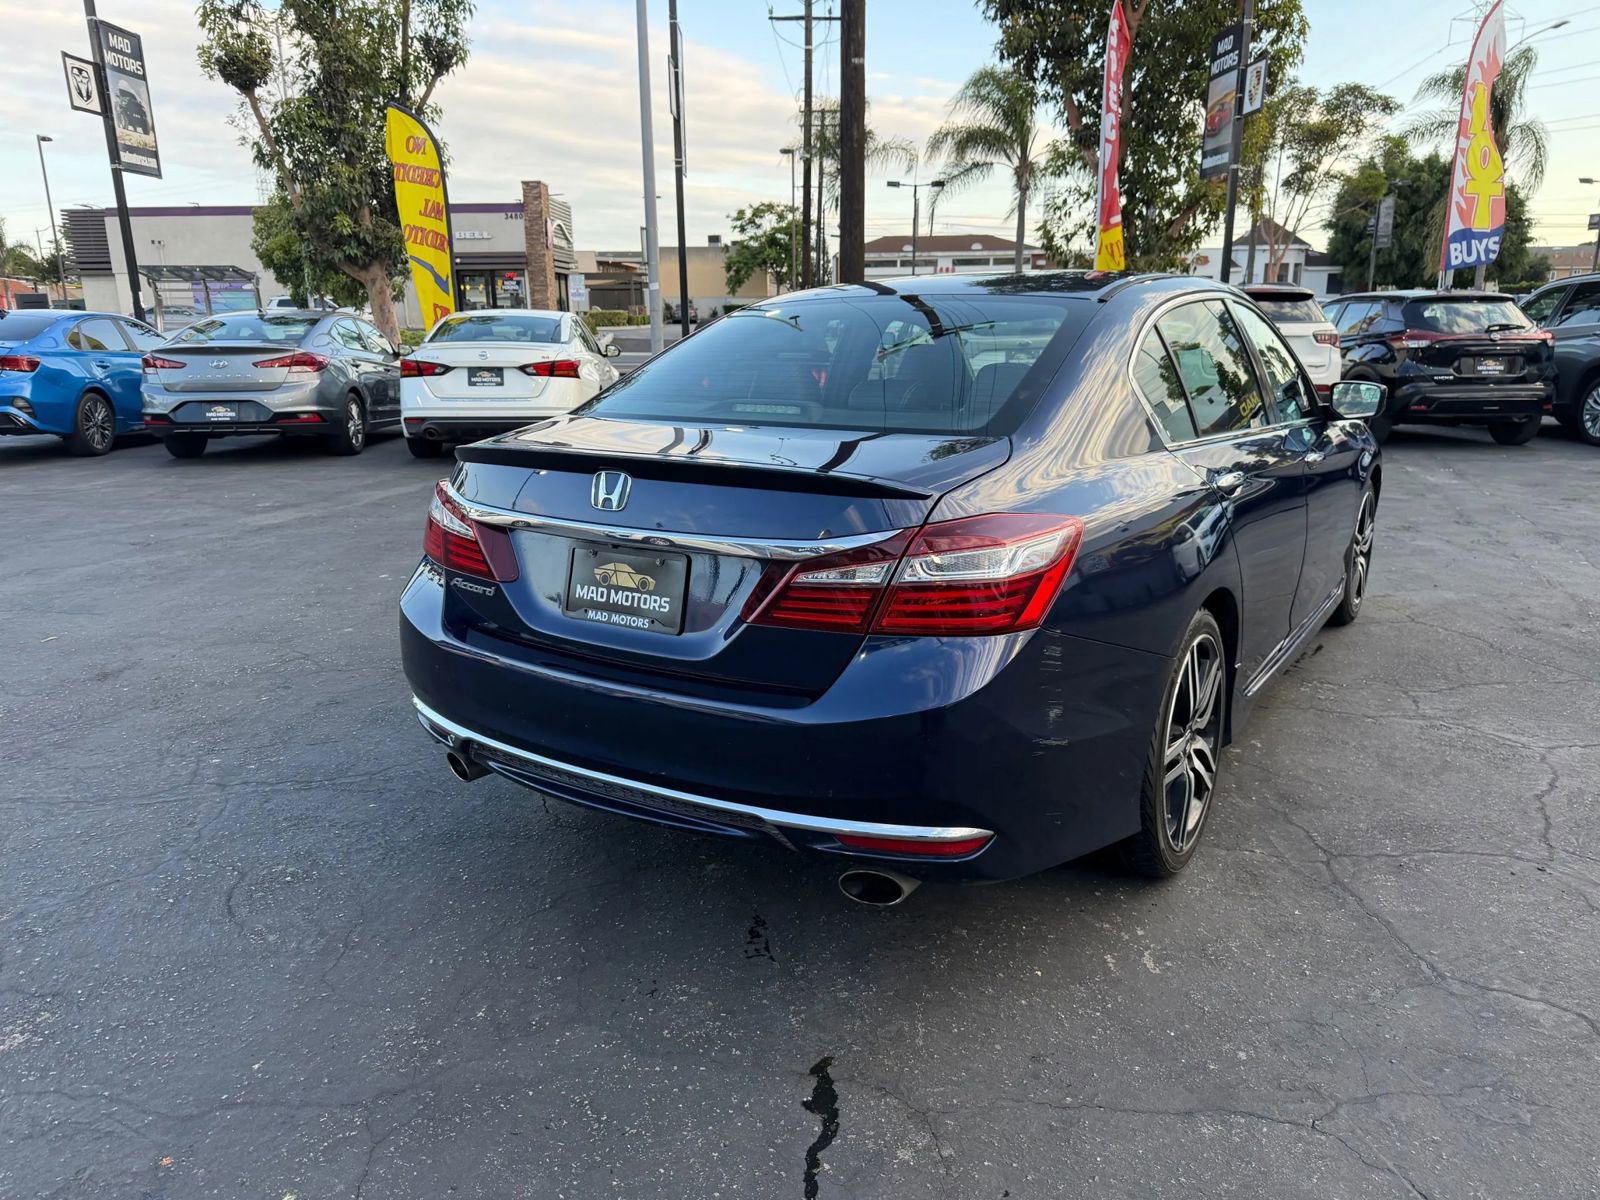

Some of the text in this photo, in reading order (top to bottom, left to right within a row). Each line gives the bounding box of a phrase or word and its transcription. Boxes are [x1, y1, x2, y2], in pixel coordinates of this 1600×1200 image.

[108, 32, 132, 54] MAD
[1217, 34, 1234, 55] MAD
[104, 49, 144, 76] MOTORS
[1210, 50, 1239, 77] MOTORS
[455, 231, 493, 241] BELL
[1449, 235, 1500, 267] BUYS
[451, 577, 496, 596] Accord
[575, 583, 671, 613] MAD MOTORS
[587, 610, 649, 629] MAD MOTORS
